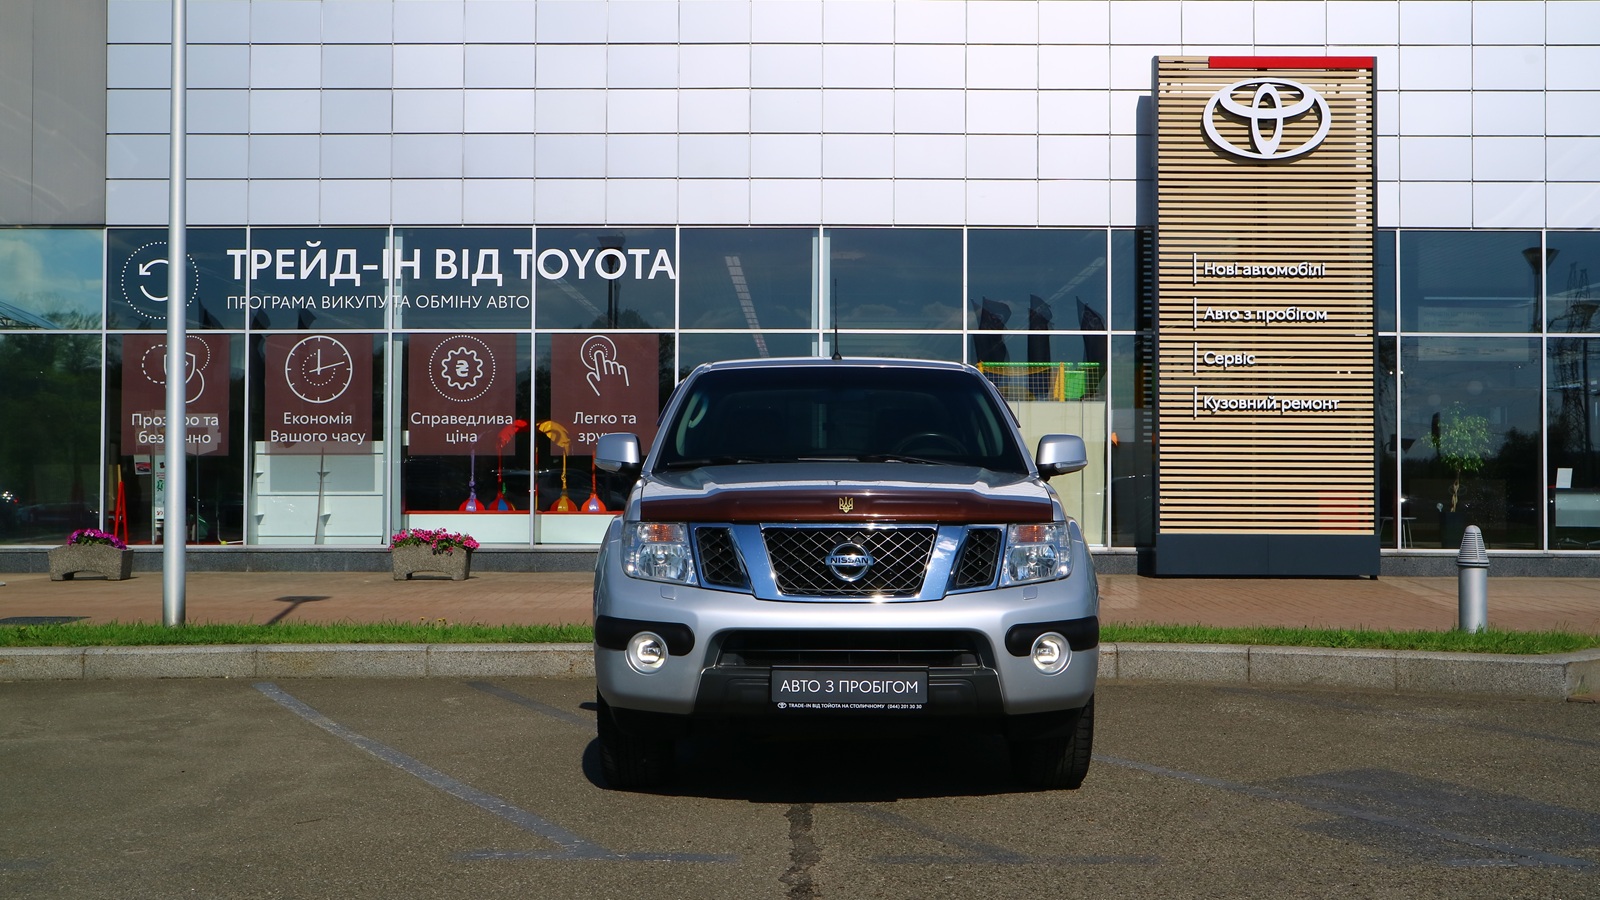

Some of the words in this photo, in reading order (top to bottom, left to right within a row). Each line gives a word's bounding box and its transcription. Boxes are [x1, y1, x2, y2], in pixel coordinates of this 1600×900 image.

[226, 240, 421, 287] ТРЕЙД-ІН
[435, 248, 503, 287] ВІД
[513, 248, 676, 280] TOYOTA
[1203, 262, 1239, 276] Нові
[1242, 262, 1326, 276] автомобілі
[226, 295, 317, 310] ПРОГРАМА
[321, 295, 388, 310] ВИКУПУ
[392, 295, 411, 309] ТА
[415, 294, 482, 309] ОБМІНУ
[486, 294, 530, 309] АВТО
[1203, 306, 1240, 320] Авто
[1243, 310, 1252, 320] з
[1256, 306, 1328, 323] пробігом
[1203, 351, 1256, 367] Сервіс
[1203, 395, 1277, 412] Кузовний
[1281, 399, 1340, 412] ремонт
[203, 416, 219, 426] та
[283, 411, 353, 425] Економія
[410, 411, 513, 428] Справедлива
[573, 411, 618, 425] Легко
[621, 414, 637, 425] та
[270, 430, 327, 443] Вашого
[331, 432, 366, 446] часу
[446, 430, 479, 444] ціна
[830, 556, 869, 564] NISSAN
[780, 680, 821, 693] АВТО
[839, 681, 919, 694] ПРОБІГОМ
